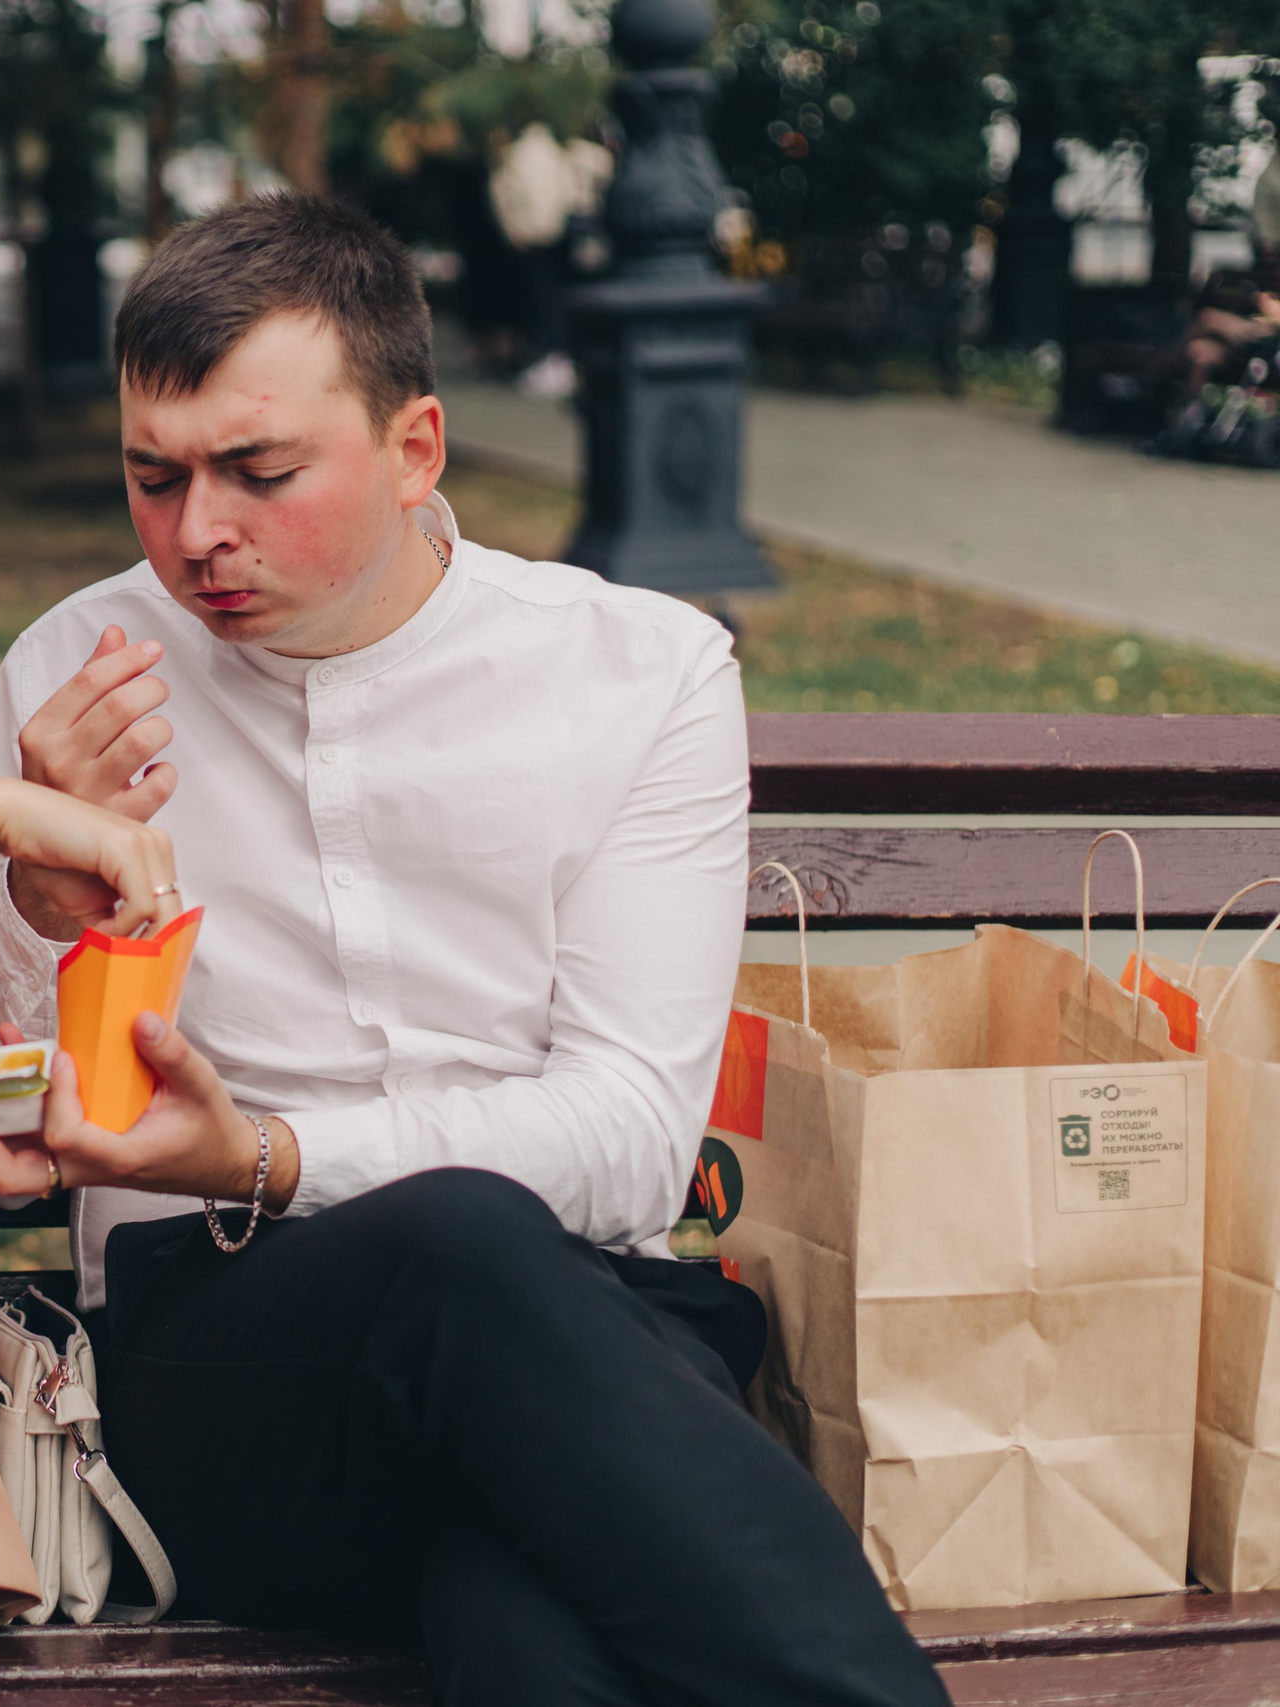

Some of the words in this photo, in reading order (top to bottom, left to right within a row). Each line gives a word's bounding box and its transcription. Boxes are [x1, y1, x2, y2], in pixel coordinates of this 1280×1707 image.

[1100, 1107, 1158, 1119] СОРТИРУЙ
[1101, 1121, 1151, 1131] ОТХОДЫ!
[1102, 1134, 1116, 1142] ИХ
[1120, 1132, 1163, 1142] МОЖНО
[1102, 1142, 1183, 1154] ПЕРЕРАБОТАТЬ!
